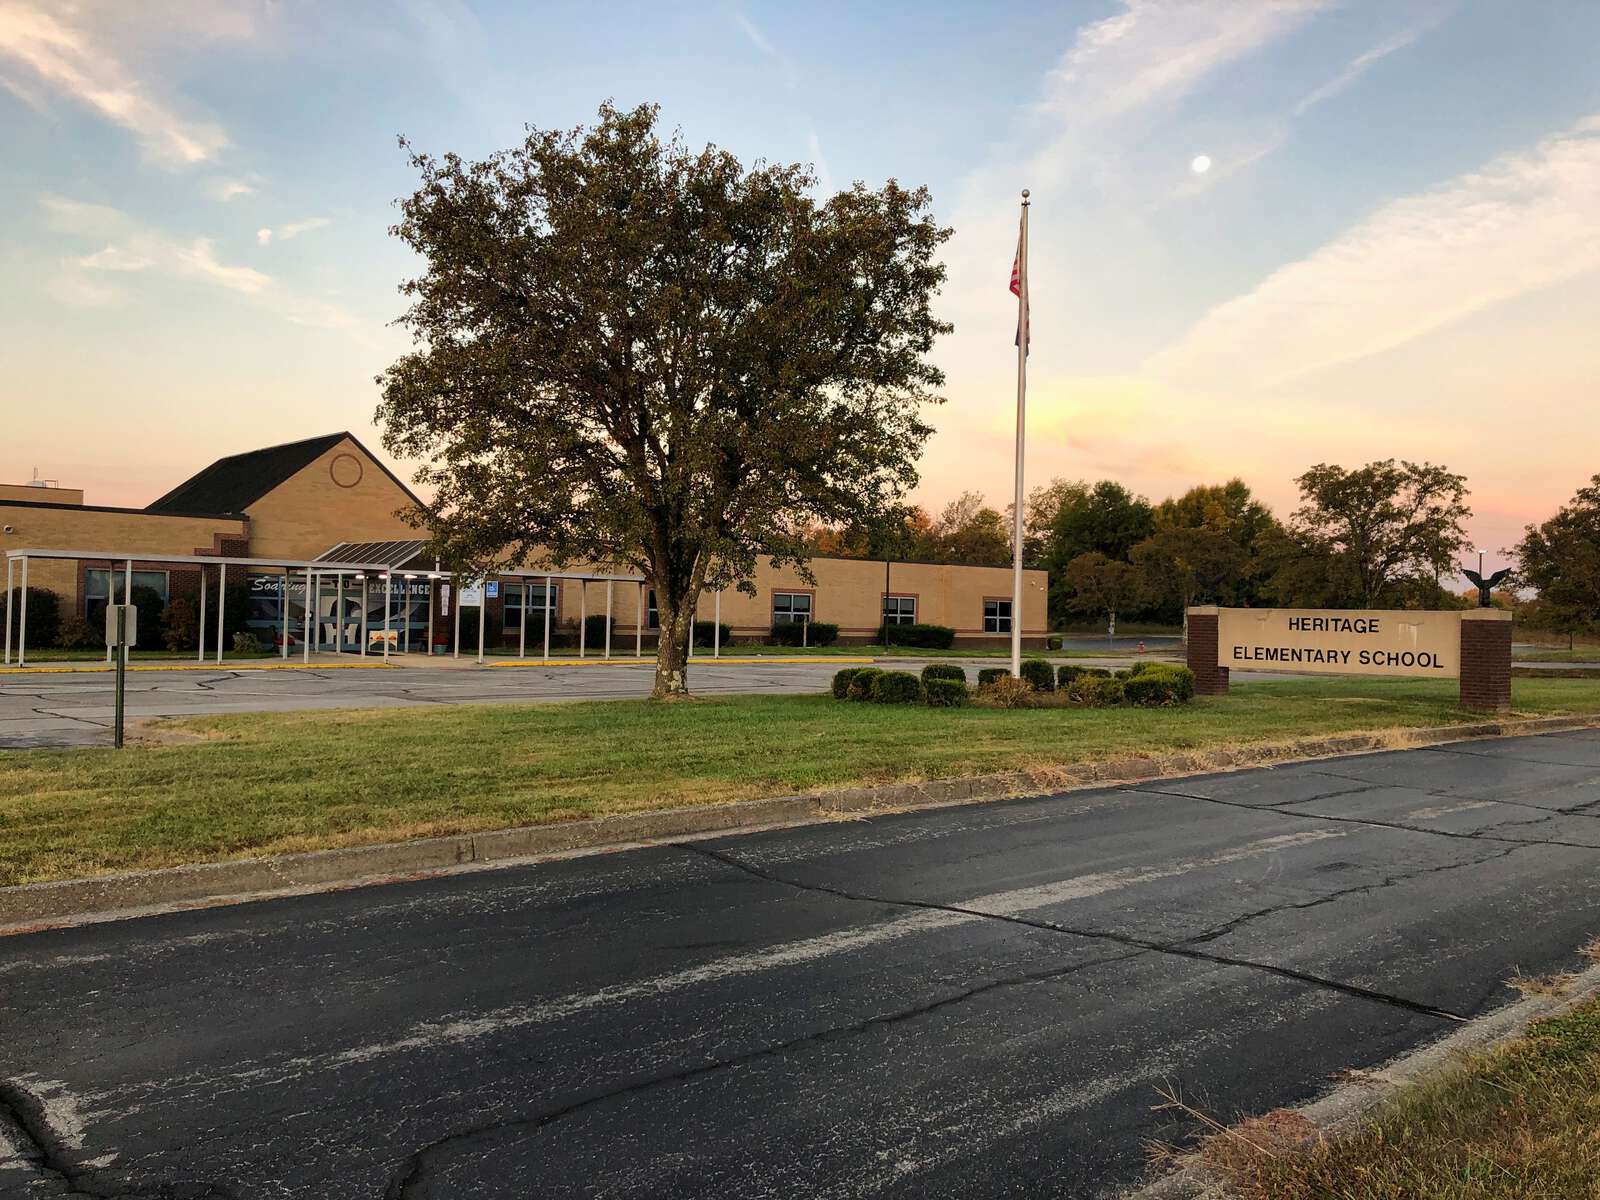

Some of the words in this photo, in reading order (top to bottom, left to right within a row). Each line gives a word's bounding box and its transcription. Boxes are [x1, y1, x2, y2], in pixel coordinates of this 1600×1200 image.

[251, 578, 305, 594] Soaring
[1288, 617, 1380, 634] HERITAGE
[1233, 645, 1351, 665] ELEMENTARY
[1358, 649, 1445, 669] SCHOOL
